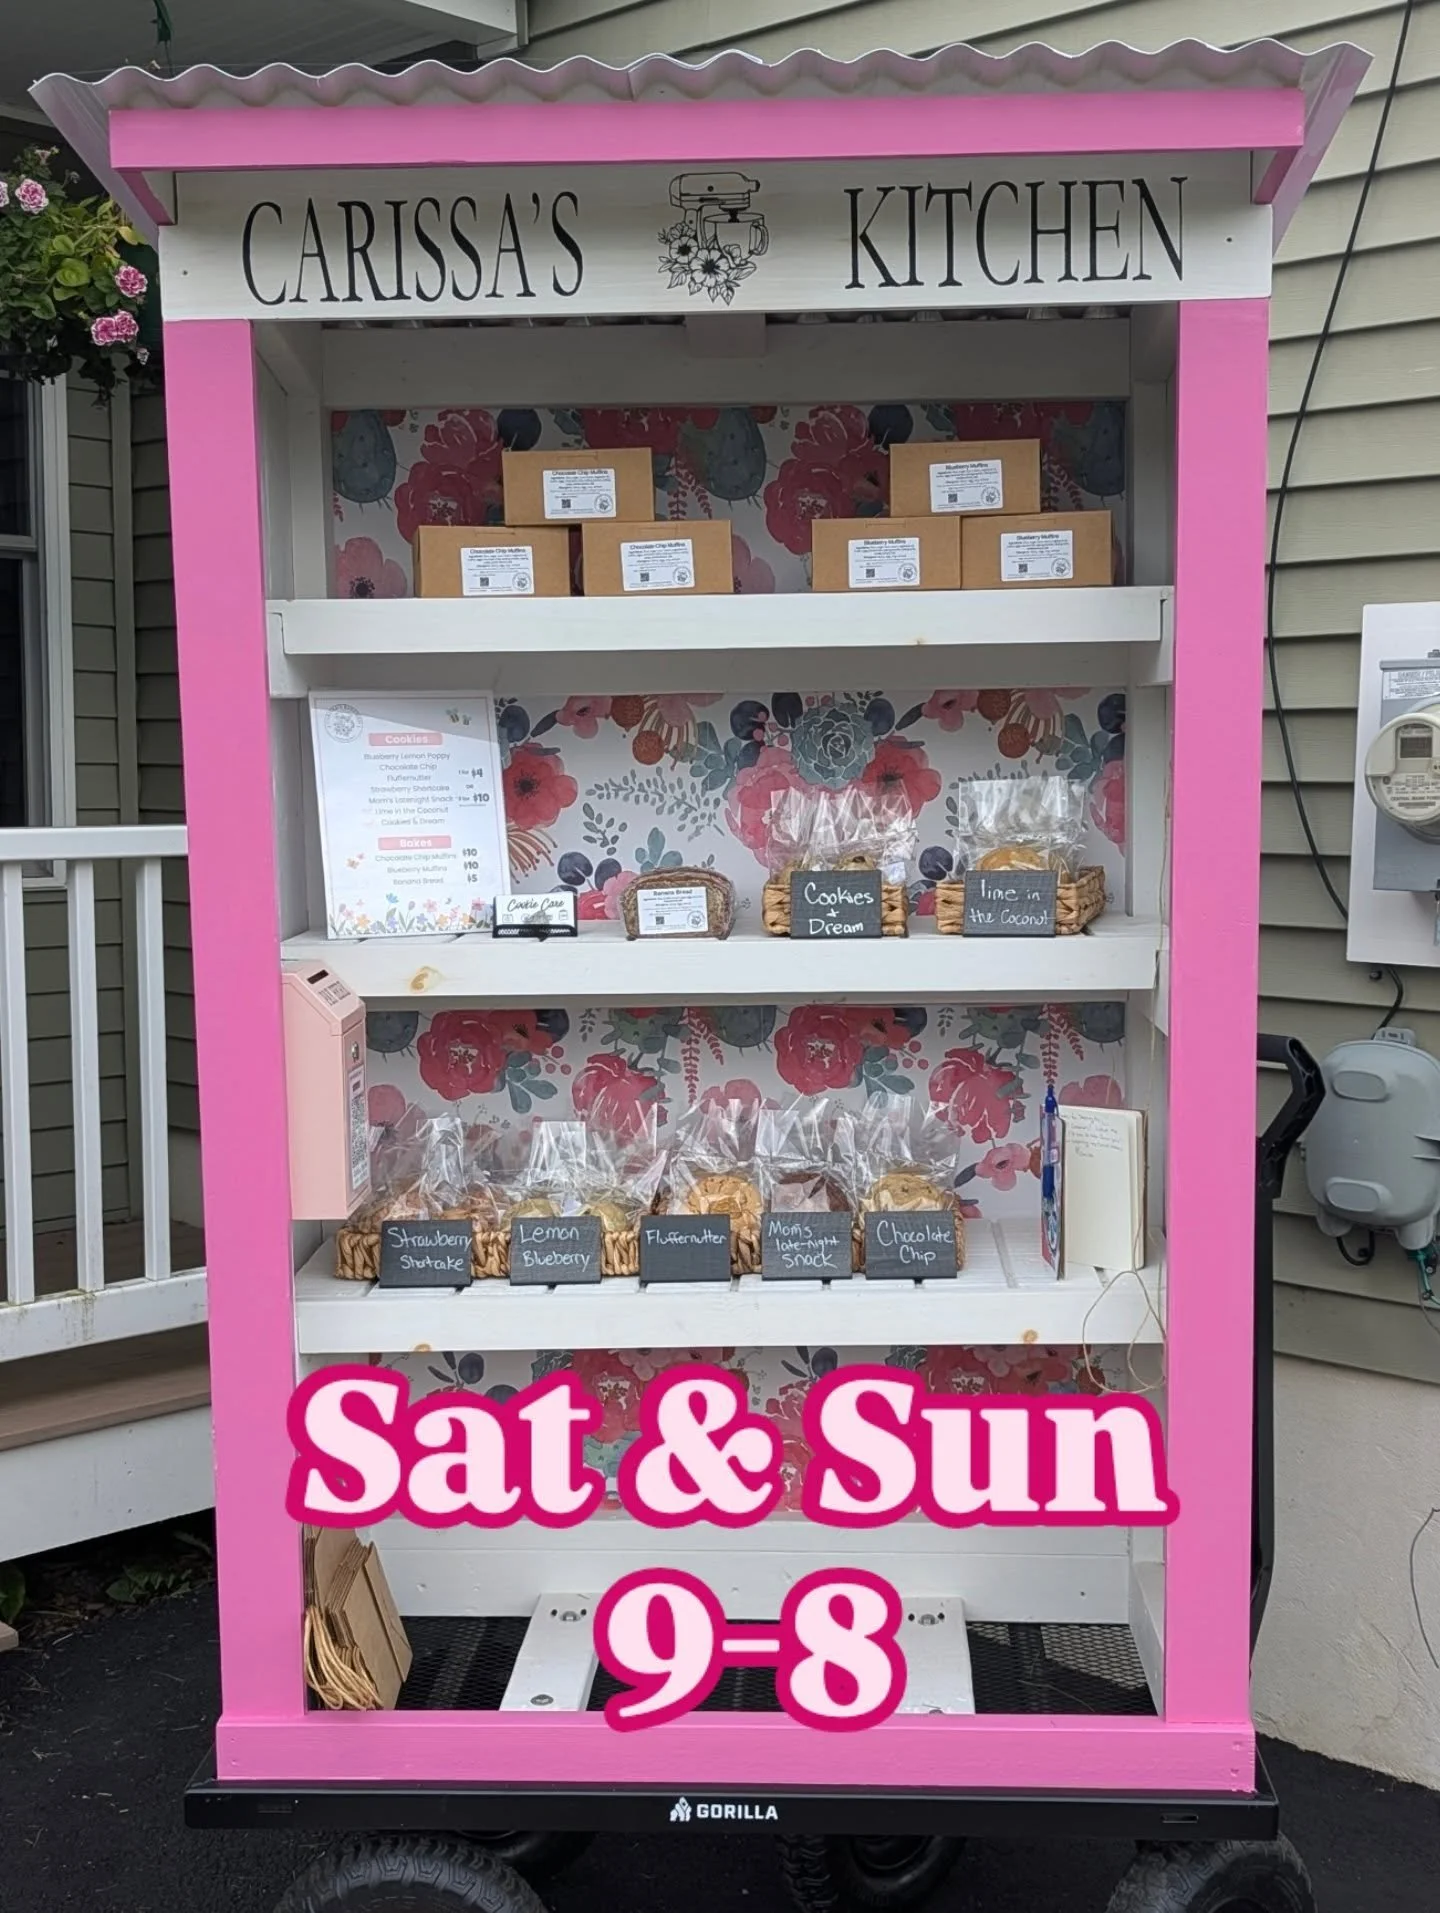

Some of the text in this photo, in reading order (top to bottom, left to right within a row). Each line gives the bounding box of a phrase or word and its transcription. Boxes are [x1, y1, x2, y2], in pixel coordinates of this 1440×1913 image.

[242, 177, 1188, 305] CARISSA'S KITCHEN
[385, 734, 428, 744] Cookies
[363, 753, 399, 761] Blueberry
[427, 752, 450, 761] Poppy
[420, 763, 438, 771] Chip
[471, 767, 483, 779] $4
[386, 774, 431, 782] Fluffernutter
[473, 793, 490, 803] $10
[400, 839, 432, 848] Bakes
[375, 854, 412, 862] Chocolate
[413, 853, 430, 861] Chip
[462, 848, 478, 857] $10
[387, 866, 421, 874] Blueberry
[463, 861, 479, 870] $10
[467, 873, 478, 883] $5
[803, 881, 874, 905] Cookies
[1025, 889, 1041, 902] in
[507, 897, 565, 912] Cookie Care
[968, 907, 1053, 926] the Coconut
[808, 919, 865, 935] Dream
[387, 1226, 472, 1252] Strawberry
[519, 1225, 581, 1244] Lemon
[645, 1229, 728, 1246] Fluffernutter
[876, 1219, 954, 1245] Chocolate
[522, 1250, 592, 1272] Blueberry
[898, 1243, 937, 1266] Chip
[400, 1255, 465, 1272] Shortcake
[696, 1803, 779, 1821] GORILLA
